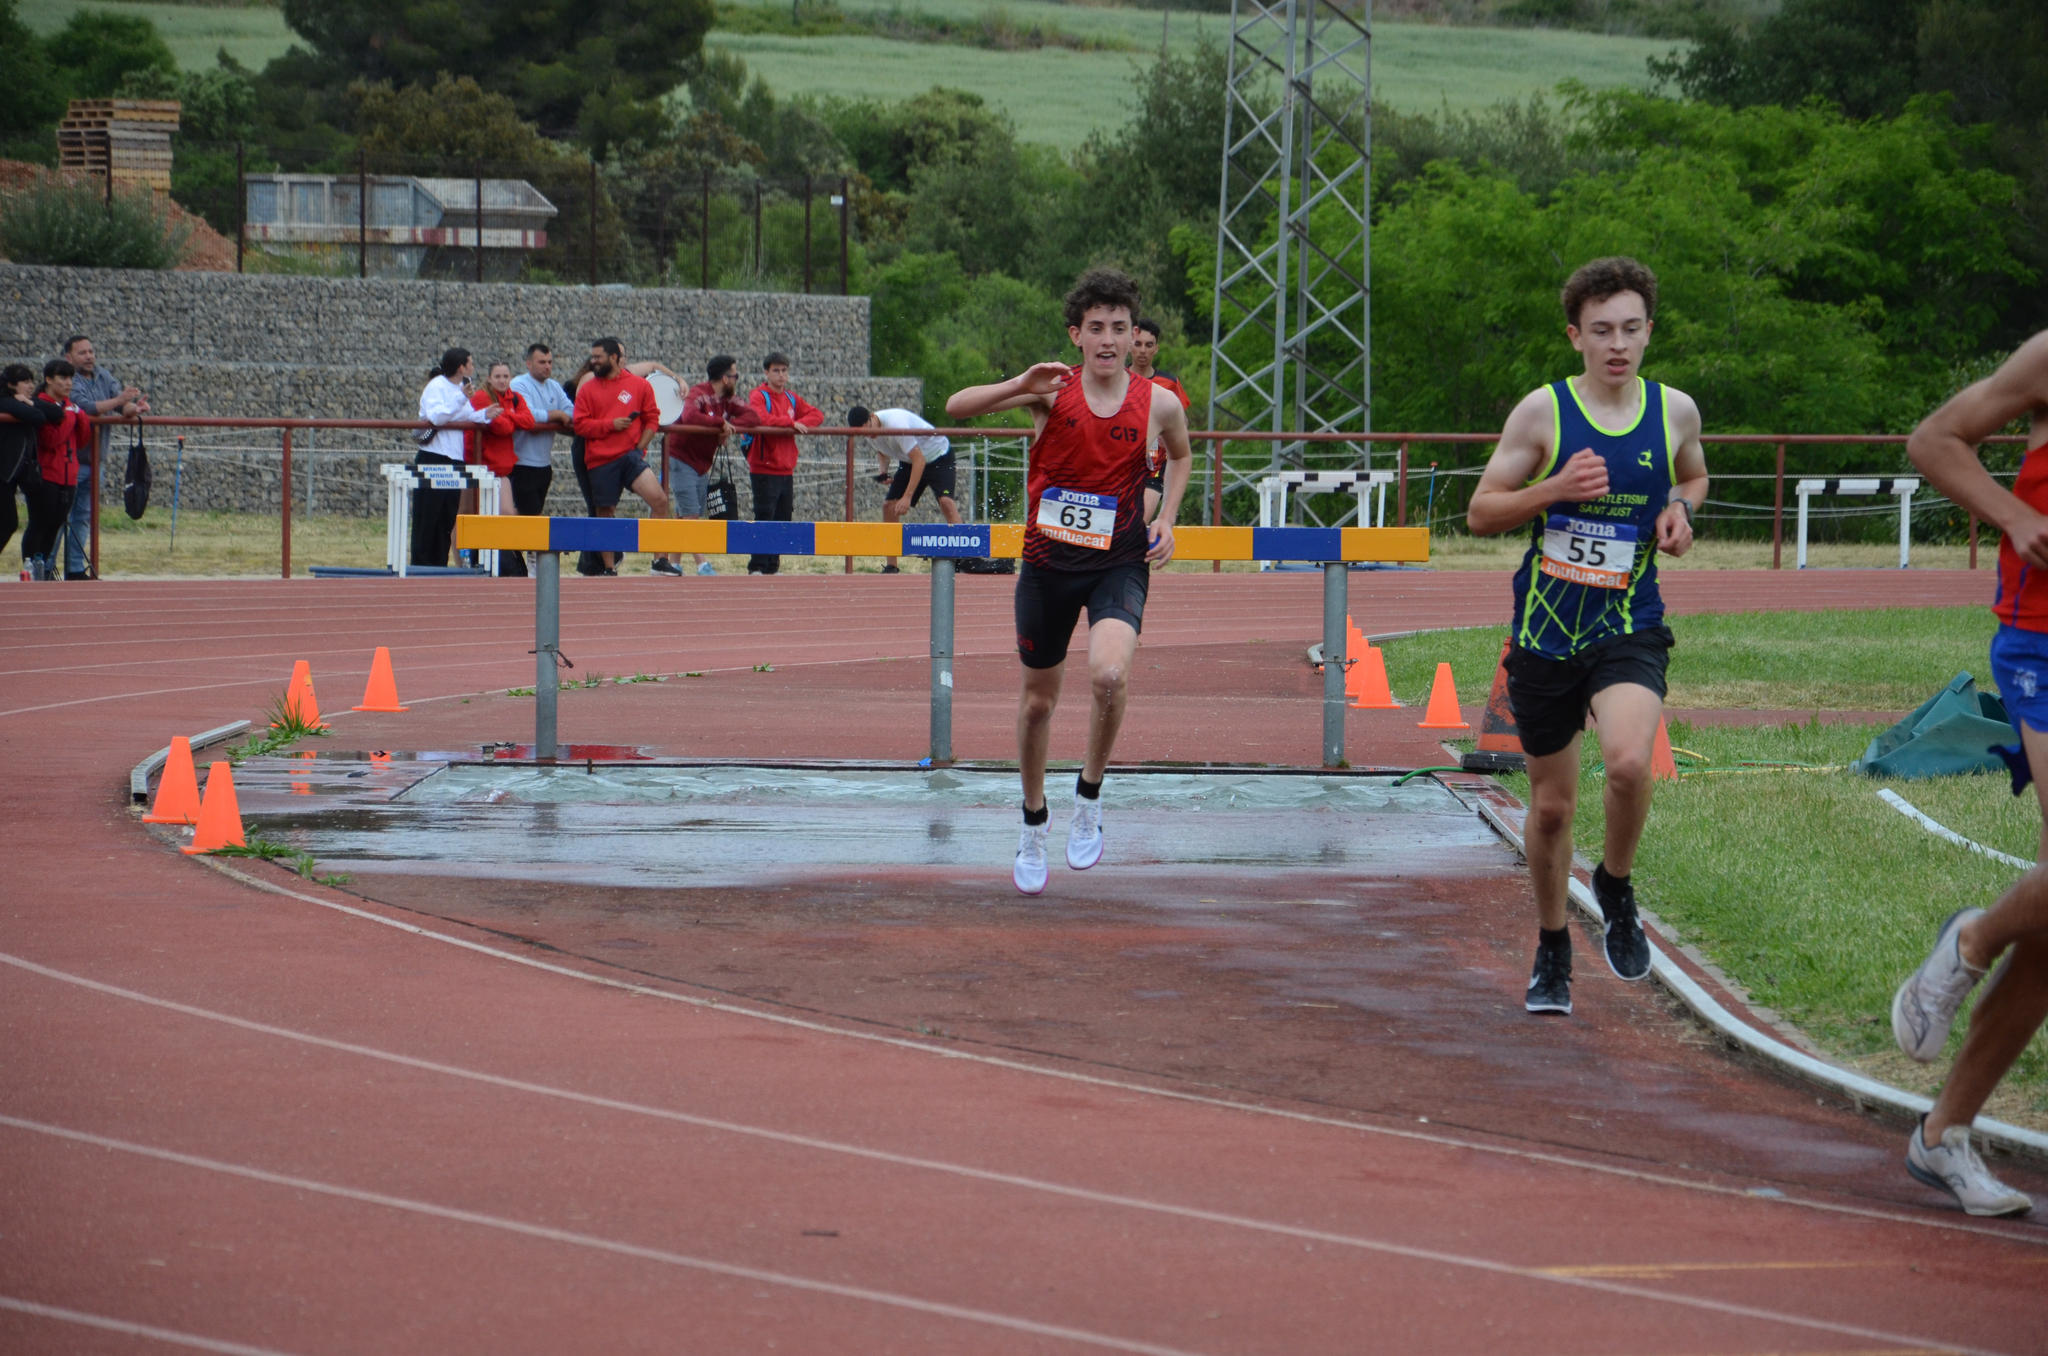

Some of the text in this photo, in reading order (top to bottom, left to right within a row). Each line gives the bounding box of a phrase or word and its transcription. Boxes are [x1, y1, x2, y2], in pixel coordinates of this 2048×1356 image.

[1058, 490, 1100, 506] Joma
[1597, 494, 1648, 504] ATLETISME
[1061, 505, 1092, 530] 63
[1579, 504, 1632, 517] SANT JUST
[1566, 519, 1616, 537] Joma
[922, 535, 981, 548] MONDO
[1040, 527, 1105, 548] mutuacat
[1567, 536, 1607, 566] 55
[1547, 561, 1622, 586] mutuacat
